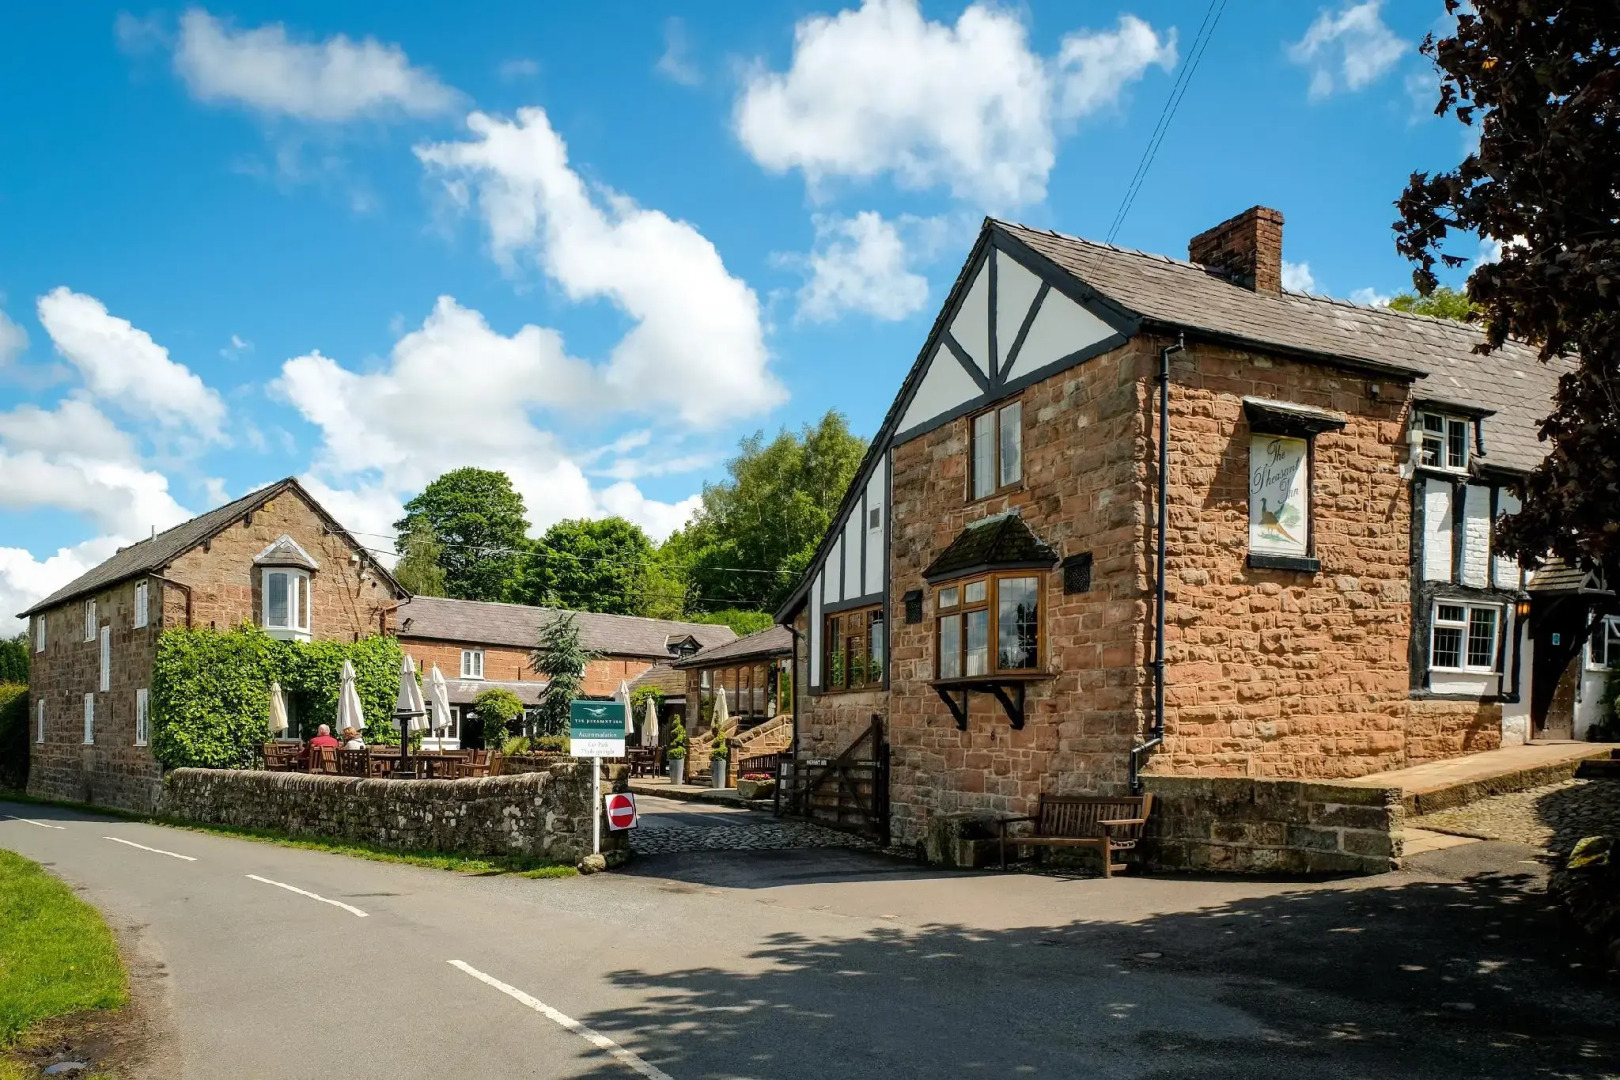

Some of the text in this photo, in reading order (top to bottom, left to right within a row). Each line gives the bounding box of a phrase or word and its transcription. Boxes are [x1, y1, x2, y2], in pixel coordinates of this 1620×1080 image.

[1267, 439, 1285, 467] The
[1251, 457, 1300, 494] Pheasant
[1278, 478, 1299, 504] Inn
